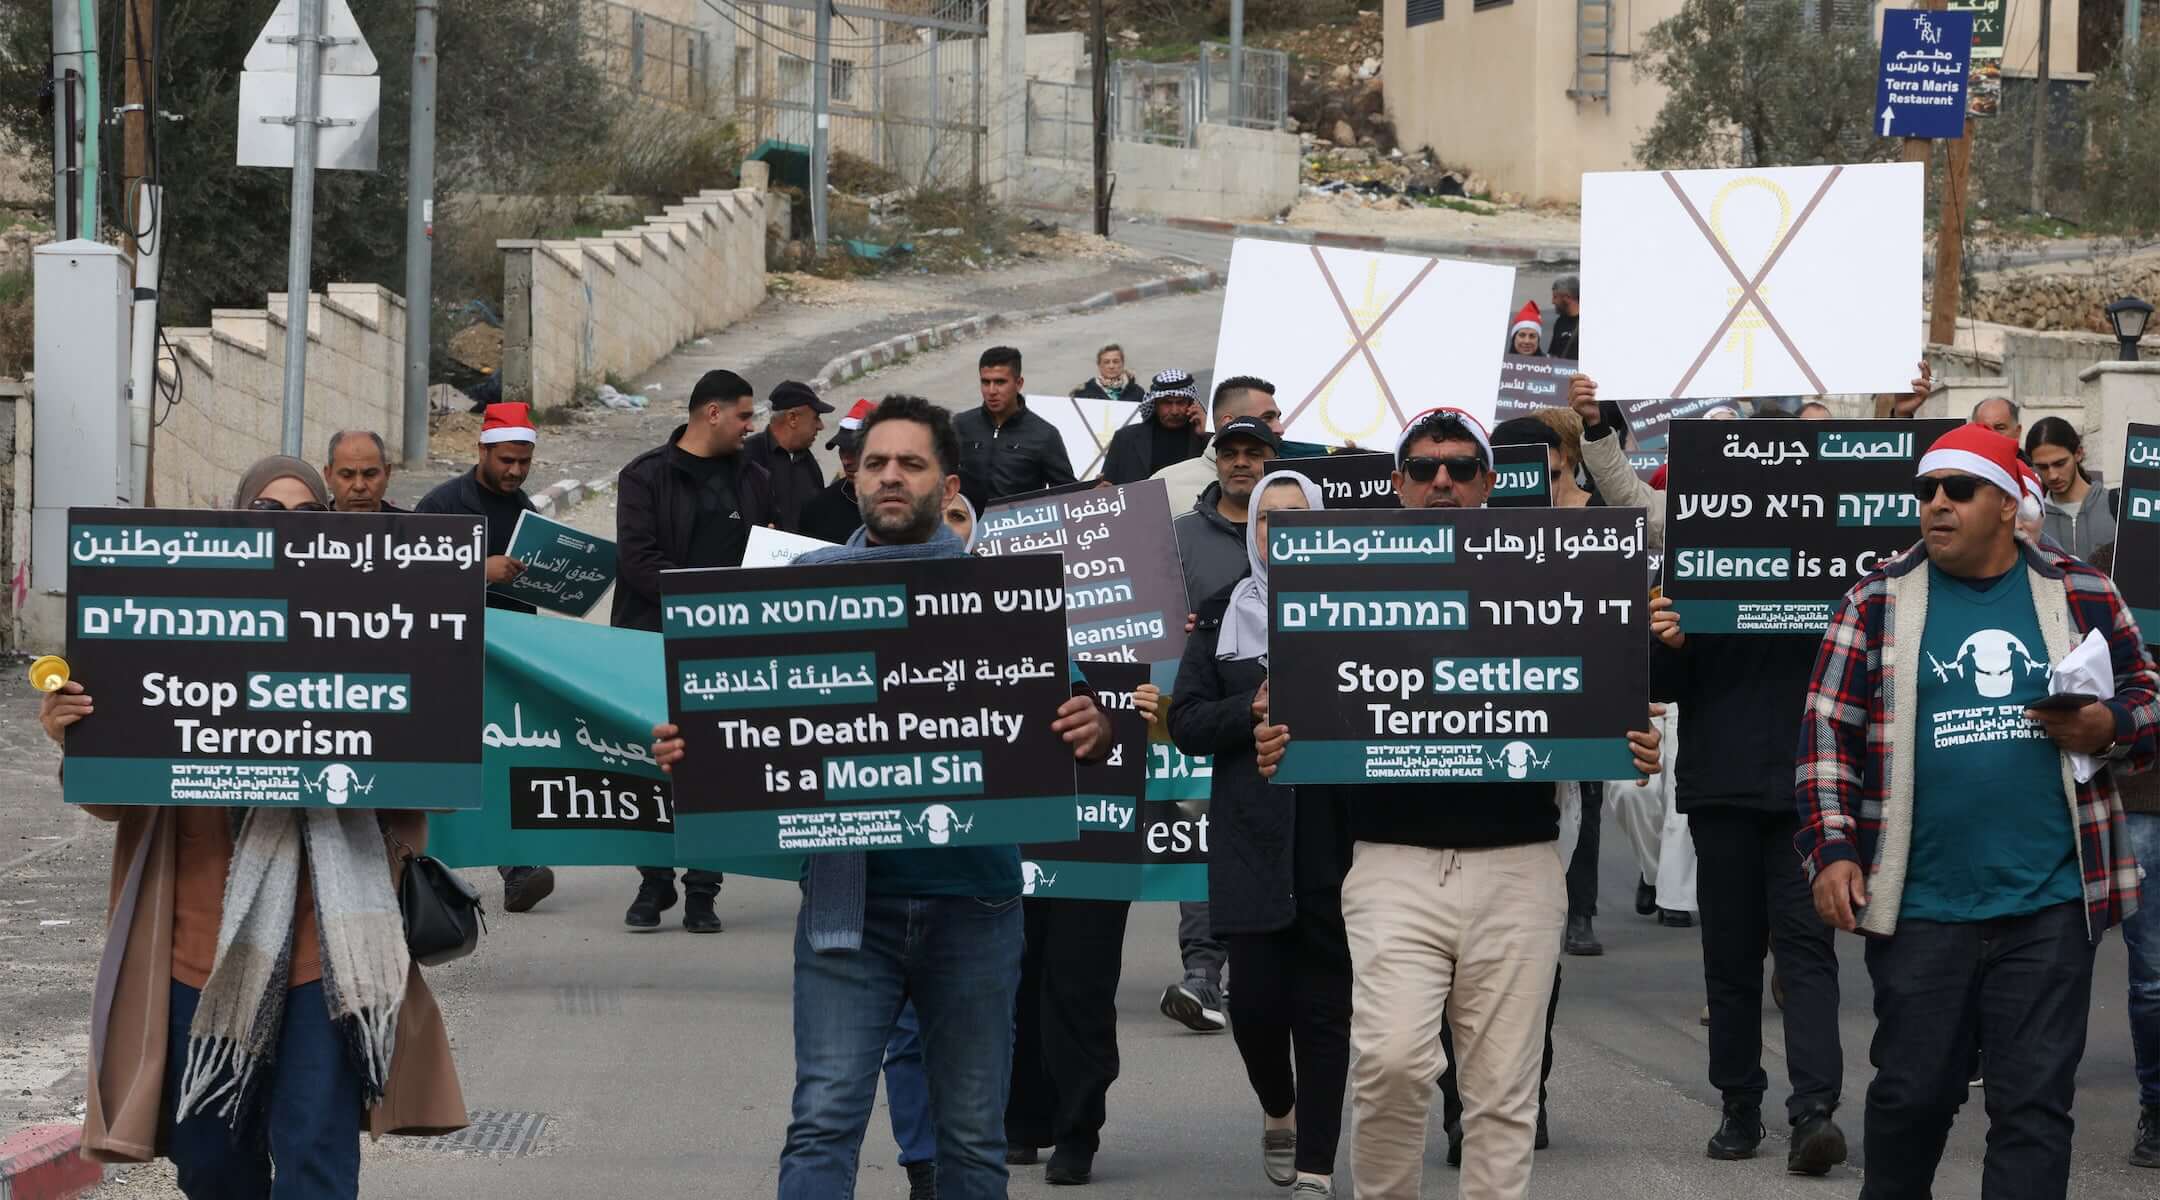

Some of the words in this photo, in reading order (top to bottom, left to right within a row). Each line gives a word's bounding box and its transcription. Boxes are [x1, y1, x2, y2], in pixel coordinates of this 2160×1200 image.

[1973, 18, 1993, 33] YX
[1885, 78, 1919, 92] Terra
[1921, 79, 1960, 93] Maris
[1888, 93, 1953, 106] Restaurant
[1497, 399, 1513, 408] om
[1514, 399, 1528, 410] for
[1632, 420, 1646, 431] No
[1646, 415, 1657, 426] to
[1655, 409, 1672, 423] the
[1671, 401, 1699, 418] Death
[1721, 432, 1812, 467] جريمة
[1821, 434, 1914, 460] الصمت
[1322, 476, 1353, 500] מל
[1359, 479, 1396, 499] שע
[1062, 486, 1128, 522] أوقفوا
[1677, 495, 1754, 521] פשע
[1767, 495, 1825, 519] היא
[1837, 491, 1921, 526] תיקה
[983, 504, 1058, 539] التطهير
[1075, 521, 1111, 551] في
[74, 530, 274, 565] المستوطنين
[285, 532, 374, 574] إرهاب
[385, 525, 484, 571] أوقفوا
[1009, 527, 1069, 553] الضفة
[1273, 529, 1454, 563] المستوطنين
[1465, 528, 1546, 565] إرهاب
[1556, 517, 1646, 560] أوقفوا
[1064, 556, 1126, 580] הפסי
[1678, 551, 1790, 578] Silence
[1798, 551, 1822, 578] is
[1830, 558, 1848, 578] a
[916, 593, 983, 617] מוות
[995, 589, 1063, 613] עונש
[1065, 584, 1133, 610] המתנ
[1284, 595, 1467, 628] המתנחלים
[1480, 592, 1585, 626] לטרור
[85, 599, 286, 637] המתנחלים
[301, 604, 415, 640] לטרור
[431, 614, 468, 641] די
[667, 607, 750, 628] מוסרי
[1599, 600, 1633, 625] די
[1736, 622, 1788, 630] COMBATANTS
[1788, 622, 1804, 630] FOR
[1804, 622, 1829, 630] PEACE
[1067, 618, 1165, 648] leansing
[685, 660, 779, 701] أخلاقية
[788, 666, 875, 695] خطيئة
[884, 660, 966, 693] الإعدام
[976, 657, 1056, 687] عقوبة
[1338, 662, 1426, 701] Stop
[1436, 659, 1580, 693] Settlers
[143, 673, 239, 717] Stop
[250, 675, 408, 711] Settlers
[481, 702, 562, 750] سلم
[719, 720, 782, 750] The
[790, 714, 890, 747] Death
[899, 709, 1024, 744] Penalty
[1368, 701, 1549, 735] Terrorism
[175, 720, 373, 756] Terrorism
[1934, 730, 2009, 749] COMBATANTS
[2011, 728, 2032, 740] FOR
[766, 765, 792, 793] is
[800, 770, 819, 792] a
[828, 757, 923, 790] Moral
[932, 756, 984, 785] Sin
[1365, 768, 1431, 778] COMBATANTS
[1431, 768, 1451, 777] FOR
[1452, 767, 1484, 777] PEACE
[171, 790, 242, 799] COMBATANTS
[243, 791, 265, 800] FOR
[266, 792, 300, 801] PEACE
[529, 775, 642, 822] This
[653, 785, 676, 824] i
[1076, 798, 1135, 830] alty
[779, 837, 848, 849] COMBATANTS
[848, 836, 869, 845] FOR
[870, 834, 903, 844] PEACE
[1143, 812, 1209, 854] est
